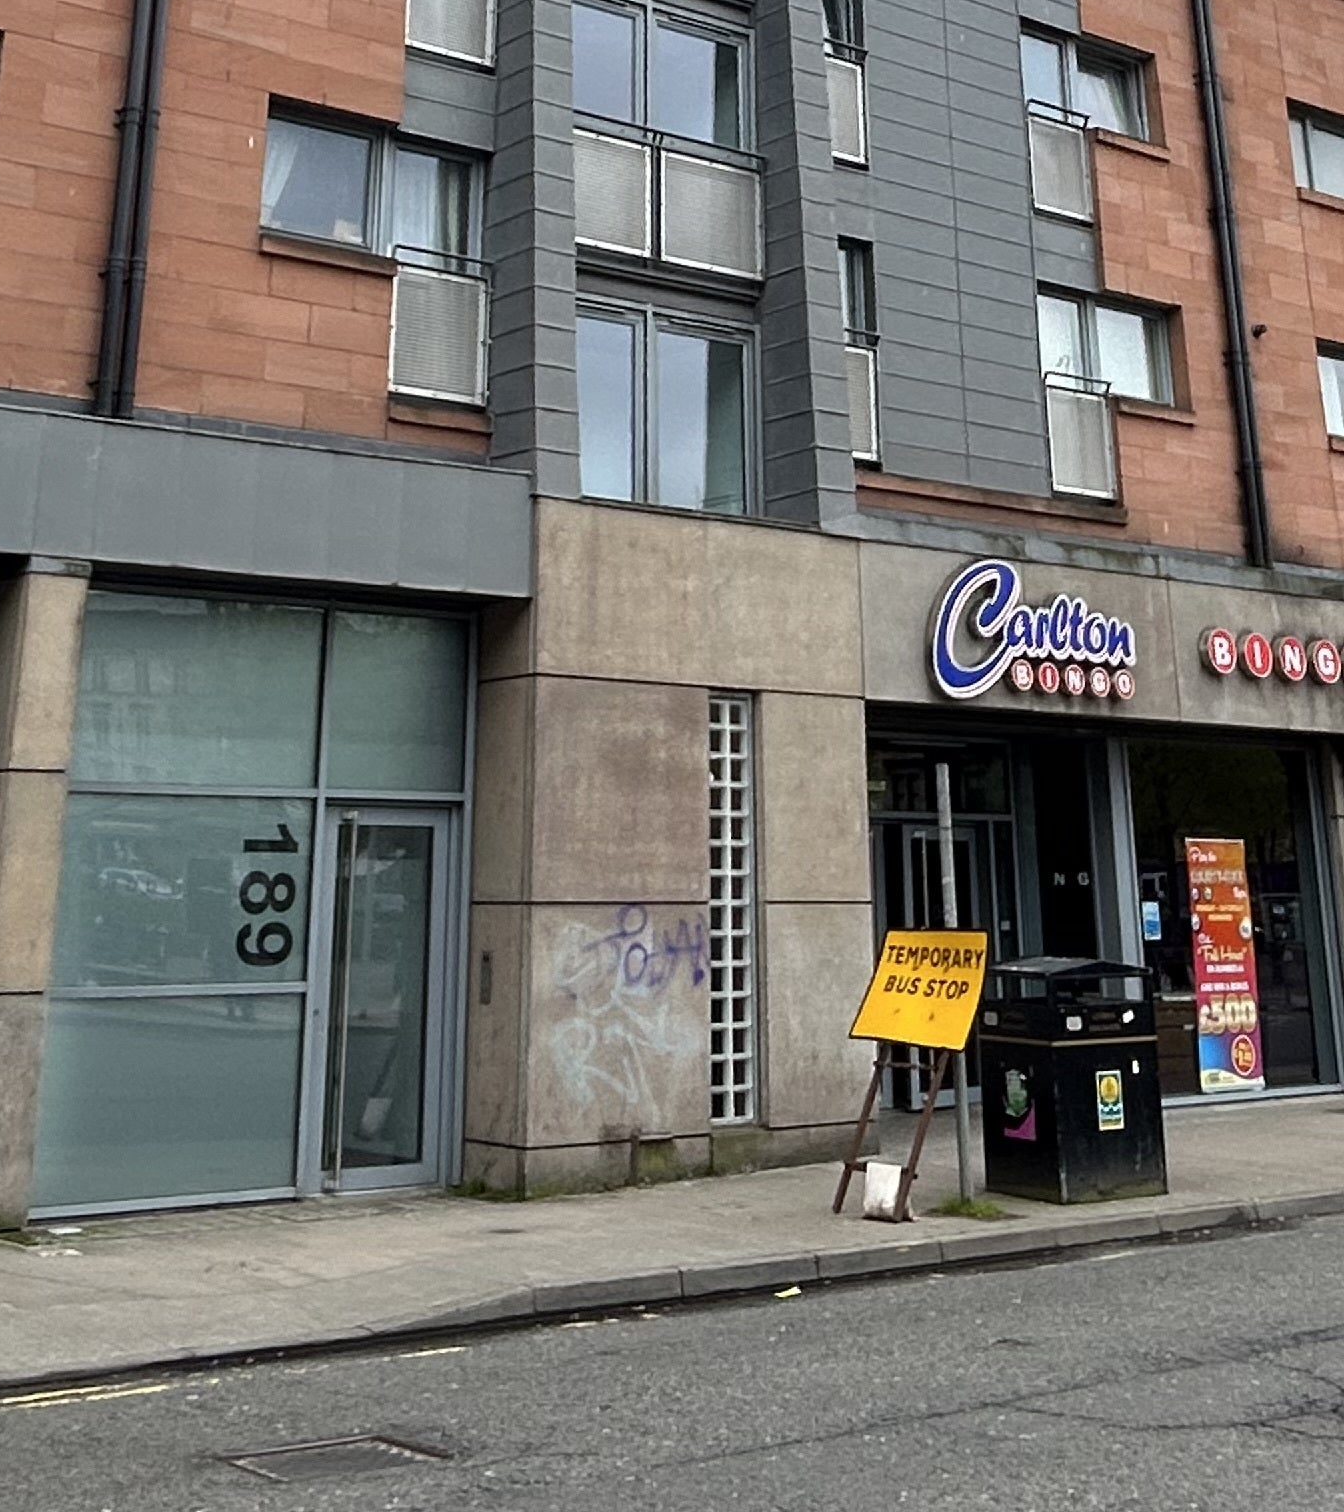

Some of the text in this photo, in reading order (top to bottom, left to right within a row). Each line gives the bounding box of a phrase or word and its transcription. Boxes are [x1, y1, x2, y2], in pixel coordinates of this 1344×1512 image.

[933, 560, 1136, 699] Carlton
[1012, 661, 1135, 698] BINGO
[235, 823, 298, 967] 189
[886, 945, 985, 969] TEMPORARY
[883, 974, 970, 999] BUS STOP
[1198, 993, 1256, 1034] £500
